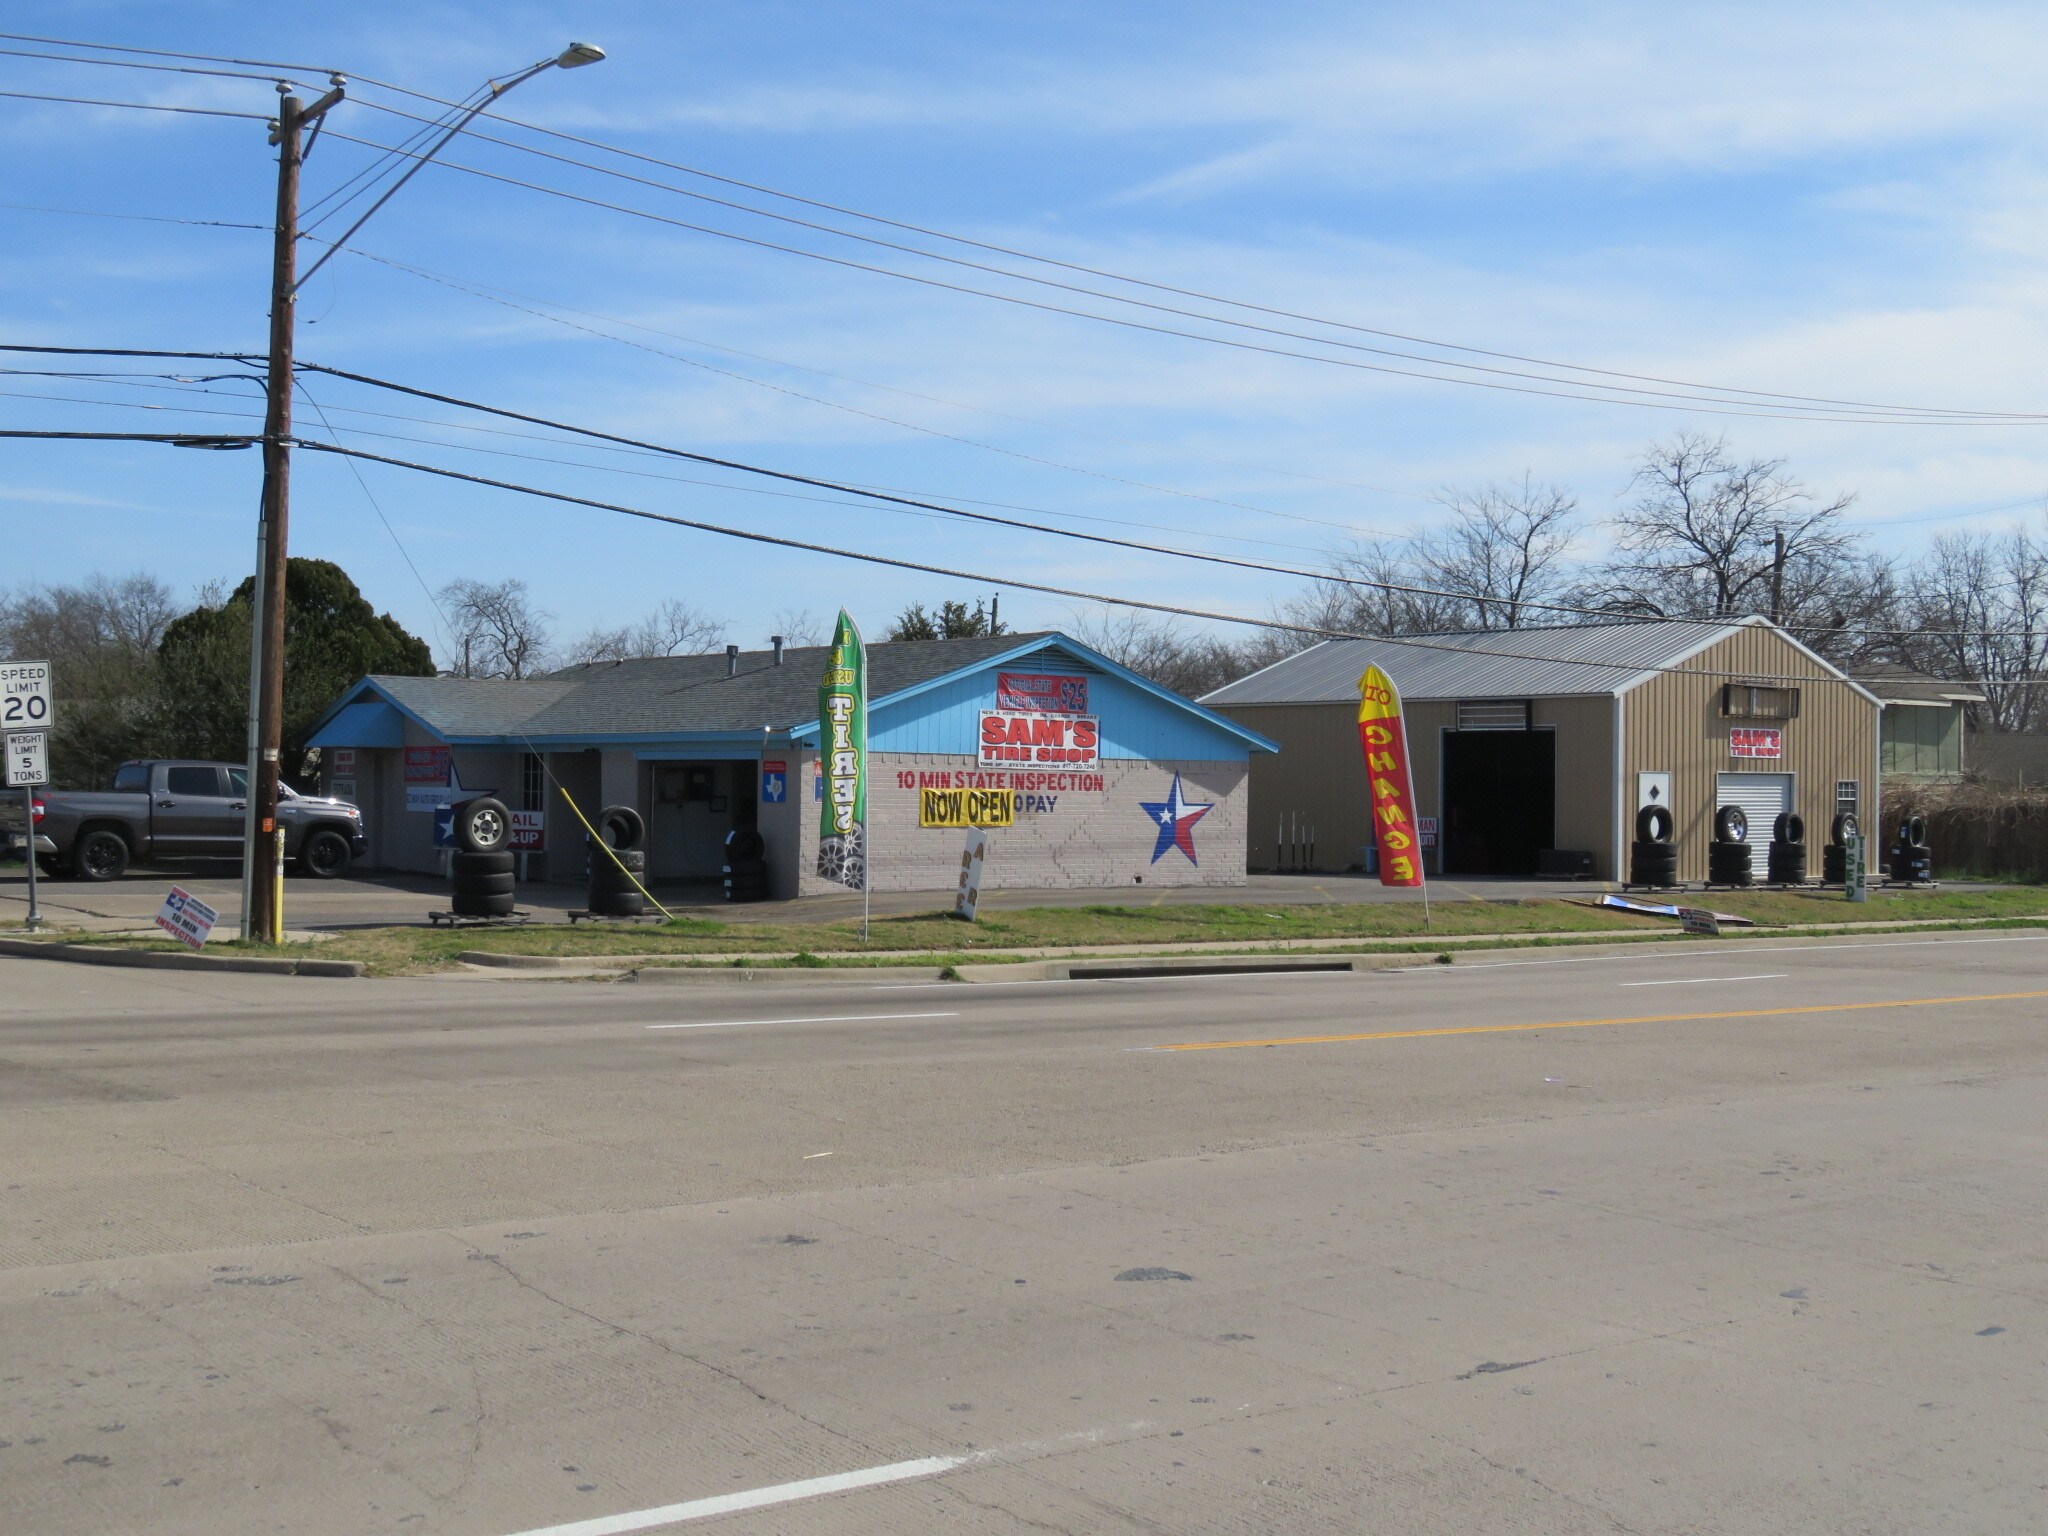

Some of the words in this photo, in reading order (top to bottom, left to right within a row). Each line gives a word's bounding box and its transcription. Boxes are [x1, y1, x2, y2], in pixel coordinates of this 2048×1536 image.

[1, 668, 46, 680] SPEED
[6, 682, 41, 693] LIMIT
[1035, 679, 1052, 693] STATE
[1060, 681, 1086, 711] $25
[4, 695, 47, 721] 20
[10, 735, 42, 744] WEIGHT
[981, 716, 1097, 748] SAM'S
[1731, 729, 1779, 747] SAM'S
[15, 745, 38, 754] LIMIT
[981, 745, 1032, 761] TIRE
[1036, 748, 1096, 763] SHOP
[1731, 747, 1752, 756] TIRE
[1755, 748, 1780, 757] SHOP
[22, 758, 32, 768] 5
[14, 770, 42, 781] TONS
[897, 771, 915, 788] 10
[919, 771, 950, 789] MIN
[955, 771, 1006, 790] STATE
[1010, 773, 1103, 792] INSPECTION
[924, 791, 963, 823] NOW
[967, 791, 1010, 823] OPEN
[1026, 795, 1058, 812] PAY
[520, 831, 539, 844] UP
[1846, 838, 1855, 898] USED
[1856, 836, 1865, 888] TIRE
[172, 913, 182, 924] 10
[181, 919, 199, 934] MIN
[155, 916, 203, 950] INSPECTION
